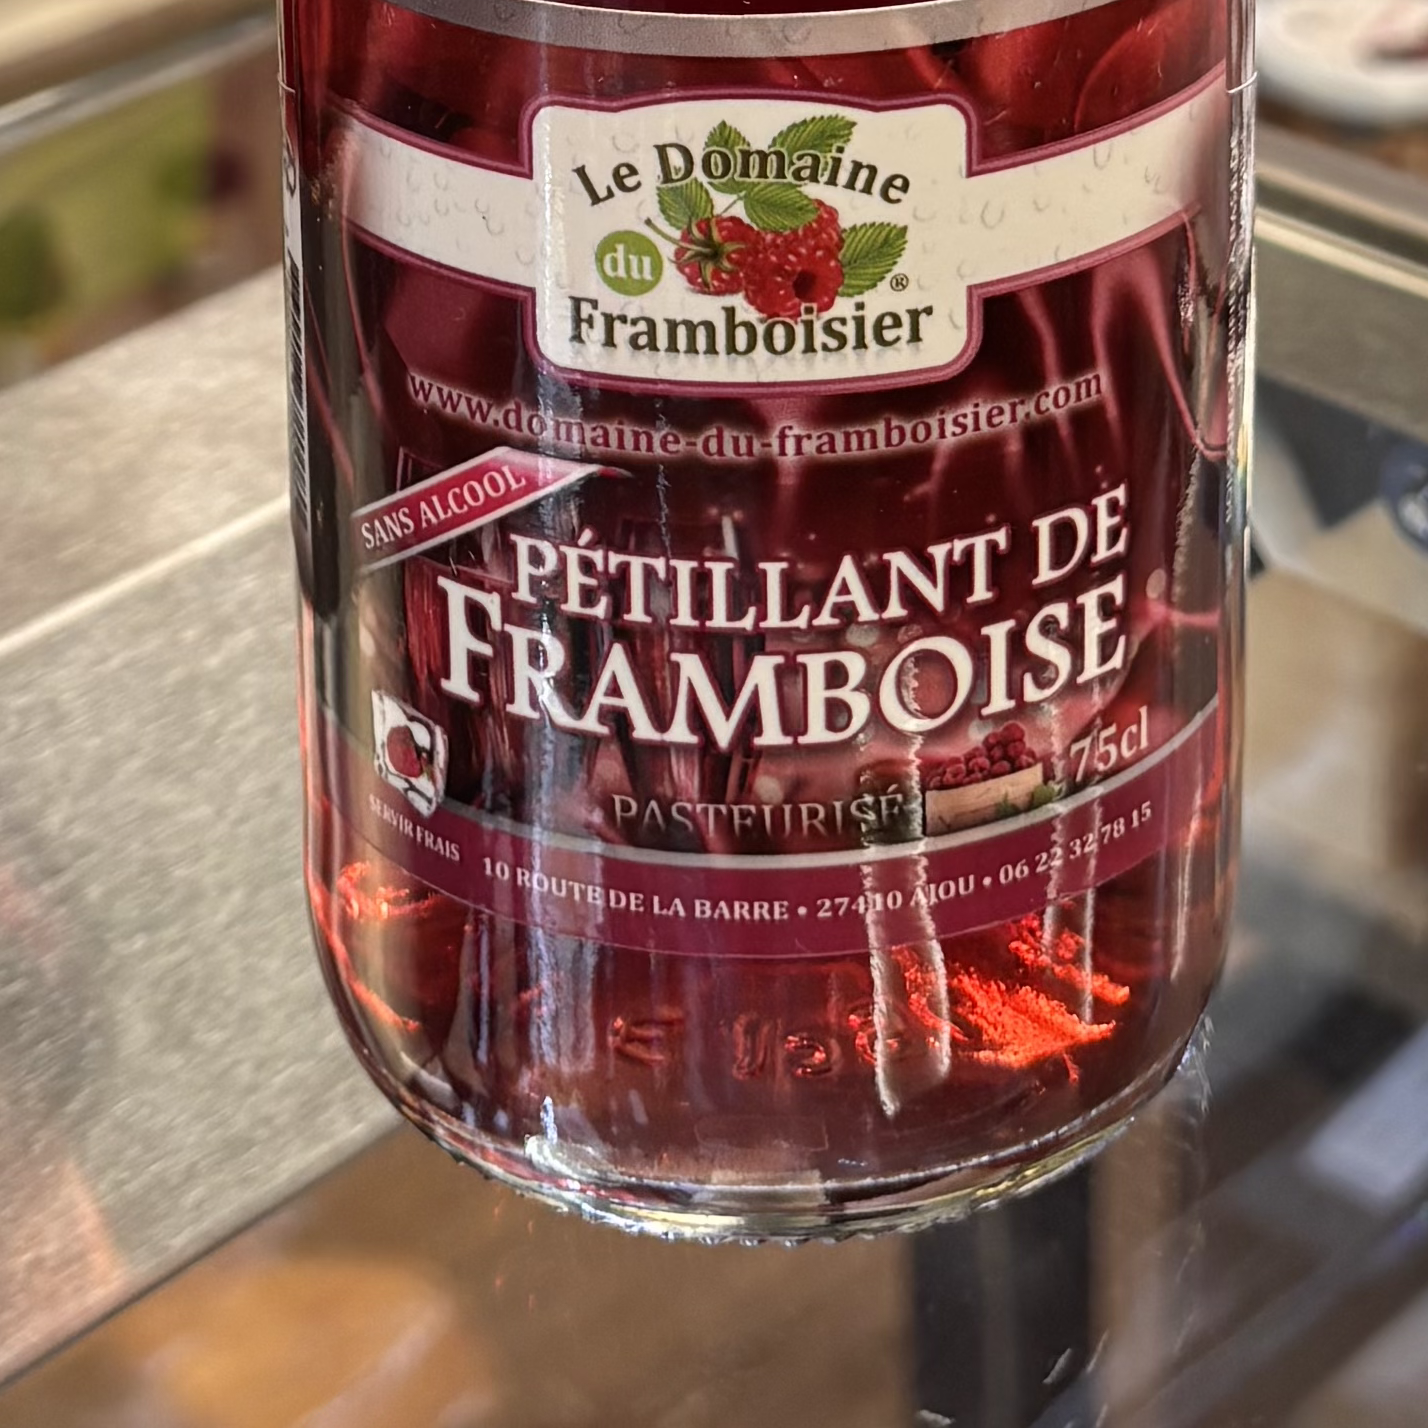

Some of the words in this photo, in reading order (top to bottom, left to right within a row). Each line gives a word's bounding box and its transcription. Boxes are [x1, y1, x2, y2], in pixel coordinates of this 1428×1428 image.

[572, 160, 642, 207] Le
[653, 142, 911, 205] Domaine
[602, 243, 654, 281] du
[568, 296, 934, 356] Framboisier
[410, 373, 1102, 458] www.domaine-du-framboisier.com
[361, 506, 415, 550] SANS
[419, 465, 526, 529] ALCOOL
[509, 526, 1012, 632] PÉTILLANT
[1031, 484, 1129, 587] DE
[438, 573, 1127, 750] FRAMBOISE
[1070, 705, 1149, 782] 75cl
[416, 826, 461, 862] FRAIS
[612, 783, 904, 839] PASTEURISÉ
[482, 856, 510, 881] 10
[517, 867, 602, 904] ROUTE
[609, 889, 645, 912] DE
[653, 895, 686, 917] LA
[694, 899, 790, 920] BARRE
[999, 860, 1029, 885] 06
[1035, 848, 1064, 873] 22
[1101, 817, 1126, 843] 78
[1130, 800, 1153, 829] 15
